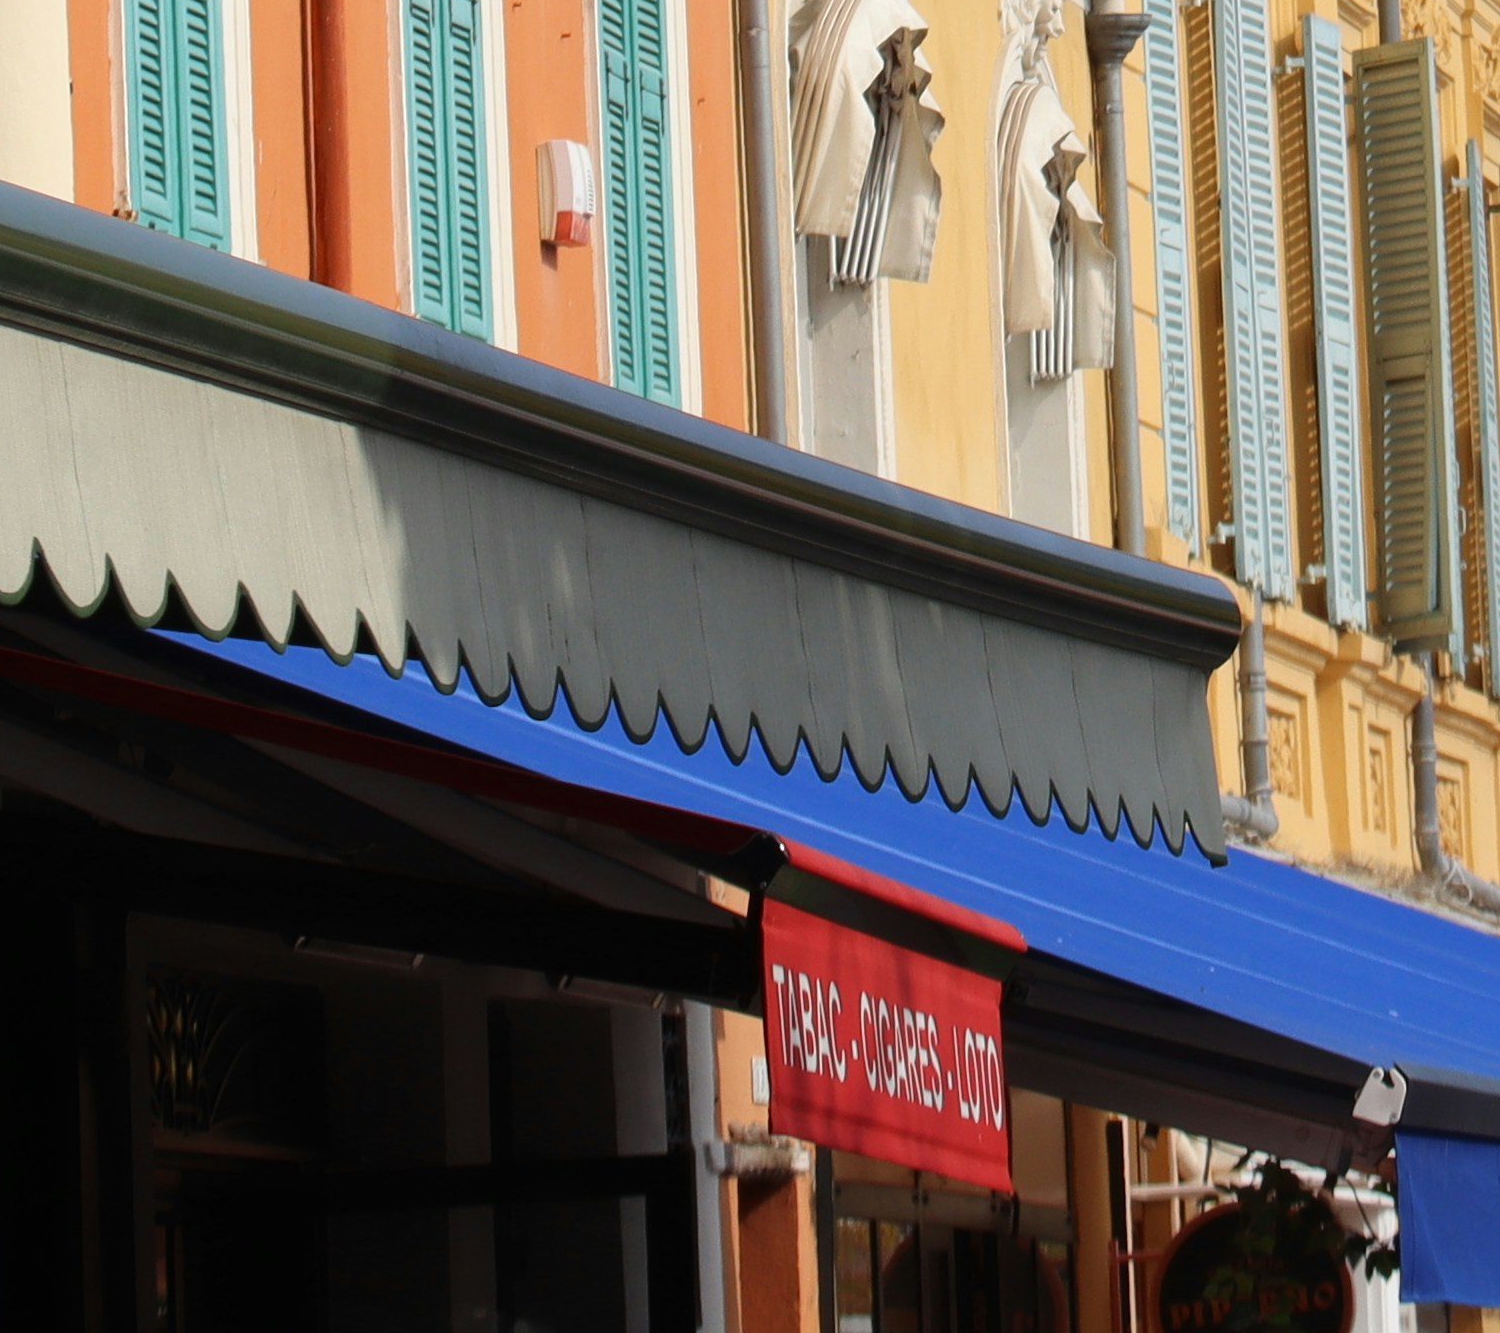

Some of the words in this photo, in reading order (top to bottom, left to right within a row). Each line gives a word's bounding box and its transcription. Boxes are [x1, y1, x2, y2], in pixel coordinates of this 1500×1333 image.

[772, 963, 846, 1083] TABAC
[860, 990, 944, 1113] CIGARES
[953, 1024, 1003, 1132] LOTO
